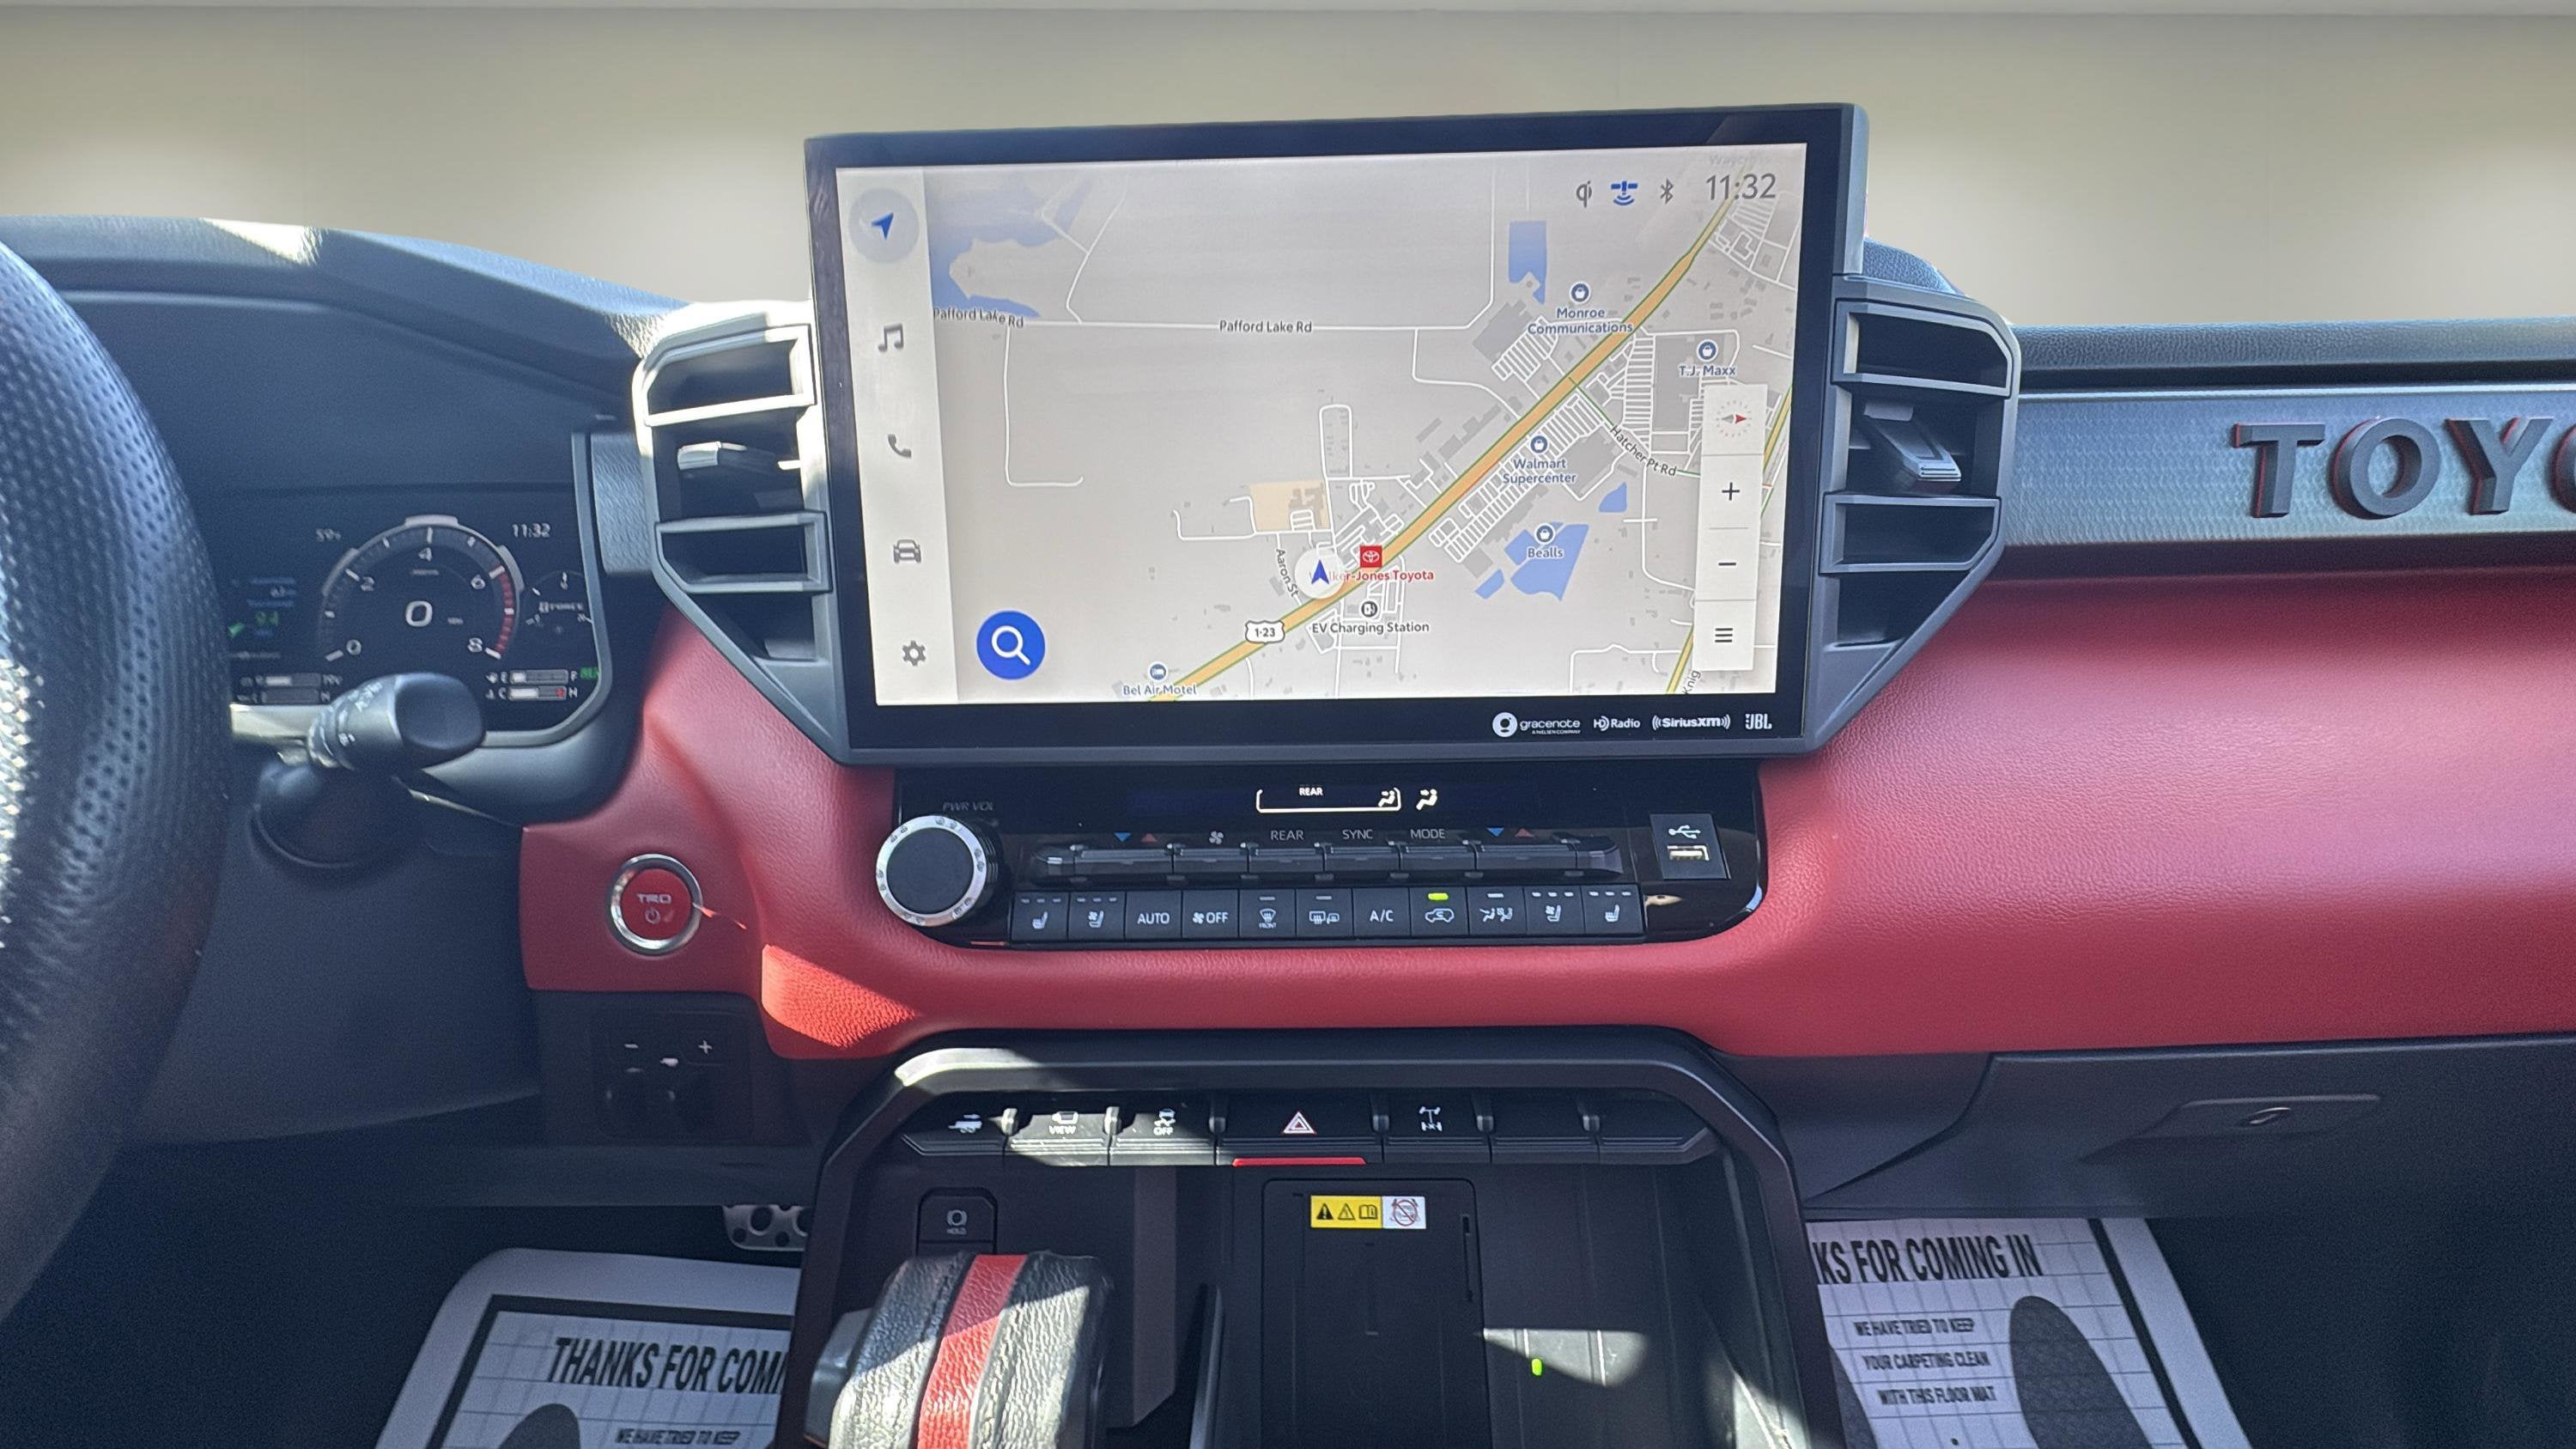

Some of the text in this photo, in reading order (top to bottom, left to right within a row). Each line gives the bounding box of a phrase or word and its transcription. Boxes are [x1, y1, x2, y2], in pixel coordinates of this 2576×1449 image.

[1705, 174, 1777, 200] 11:32
[933, 307, 1024, 328] Pafford Lake Rd
[1556, 307, 1606, 319] Monroe
[1219, 320, 1312, 333] Pafford Lake Rd
[1528, 322, 1633, 335] Communications
[1679, 366, 1736, 376] T.J. Maxx
[1610, 424, 1677, 476] Hatcher Pt Rd
[1514, 459, 1566, 470] Walmart
[2231, 416, 2576, 520] TOY
[1503, 472, 1577, 484] Supercenter
[513, 523, 550, 538] 11:32
[418, 547, 432, 561] 4
[1528, 548, 1564, 558] Bealls
[1276, 549, 1299, 597] Aaron St
[1393, 570, 1434, 582] Toyota
[361, 576, 375, 591] 2
[471, 574, 486, 589] 6
[405, 600, 433, 627] 0
[1312, 622, 1430, 636] EV Charging Station
[347, 639, 361, 655] 0
[467, 637, 483, 653] 8
[1123, 685, 1197, 696] Bel Air Motel
[1520, 718, 1581, 731] gracenote
[1611, 718, 1640, 729] Radio
[1745, 714, 1772, 730] JBL
[1299, 788, 1323, 796] REAR
[1271, 830, 1304, 841] REAR
[1342, 829, 1374, 840] SYNC
[1411, 829, 1446, 840] MODE
[636, 893, 671, 904] TRD
[1137, 912, 1170, 925] AUTO
[1206, 911, 1229, 924] OFF
[1370, 909, 1394, 922] A/C
[1049, 1125, 1076, 1135] VIEW
[1153, 1126, 1173, 1136] OFF
[1850, 1239, 1907, 1283] FOR
[1905, 1235, 2009, 1282] COMING
[2006, 1233, 2044, 1277] IN
[1853, 1318, 1974, 1336] WE HAVE TRIED TO KEEP
[548, 1336, 659, 1389] THANKS
[658, 1344, 716, 1392] FOR
[1862, 1351, 1991, 1370] YOUR CARPETING CLEAN
[1876, 1385, 1996, 1405] WITH THIS FLOOR MAT
[617, 1428, 634, 1444] WE
